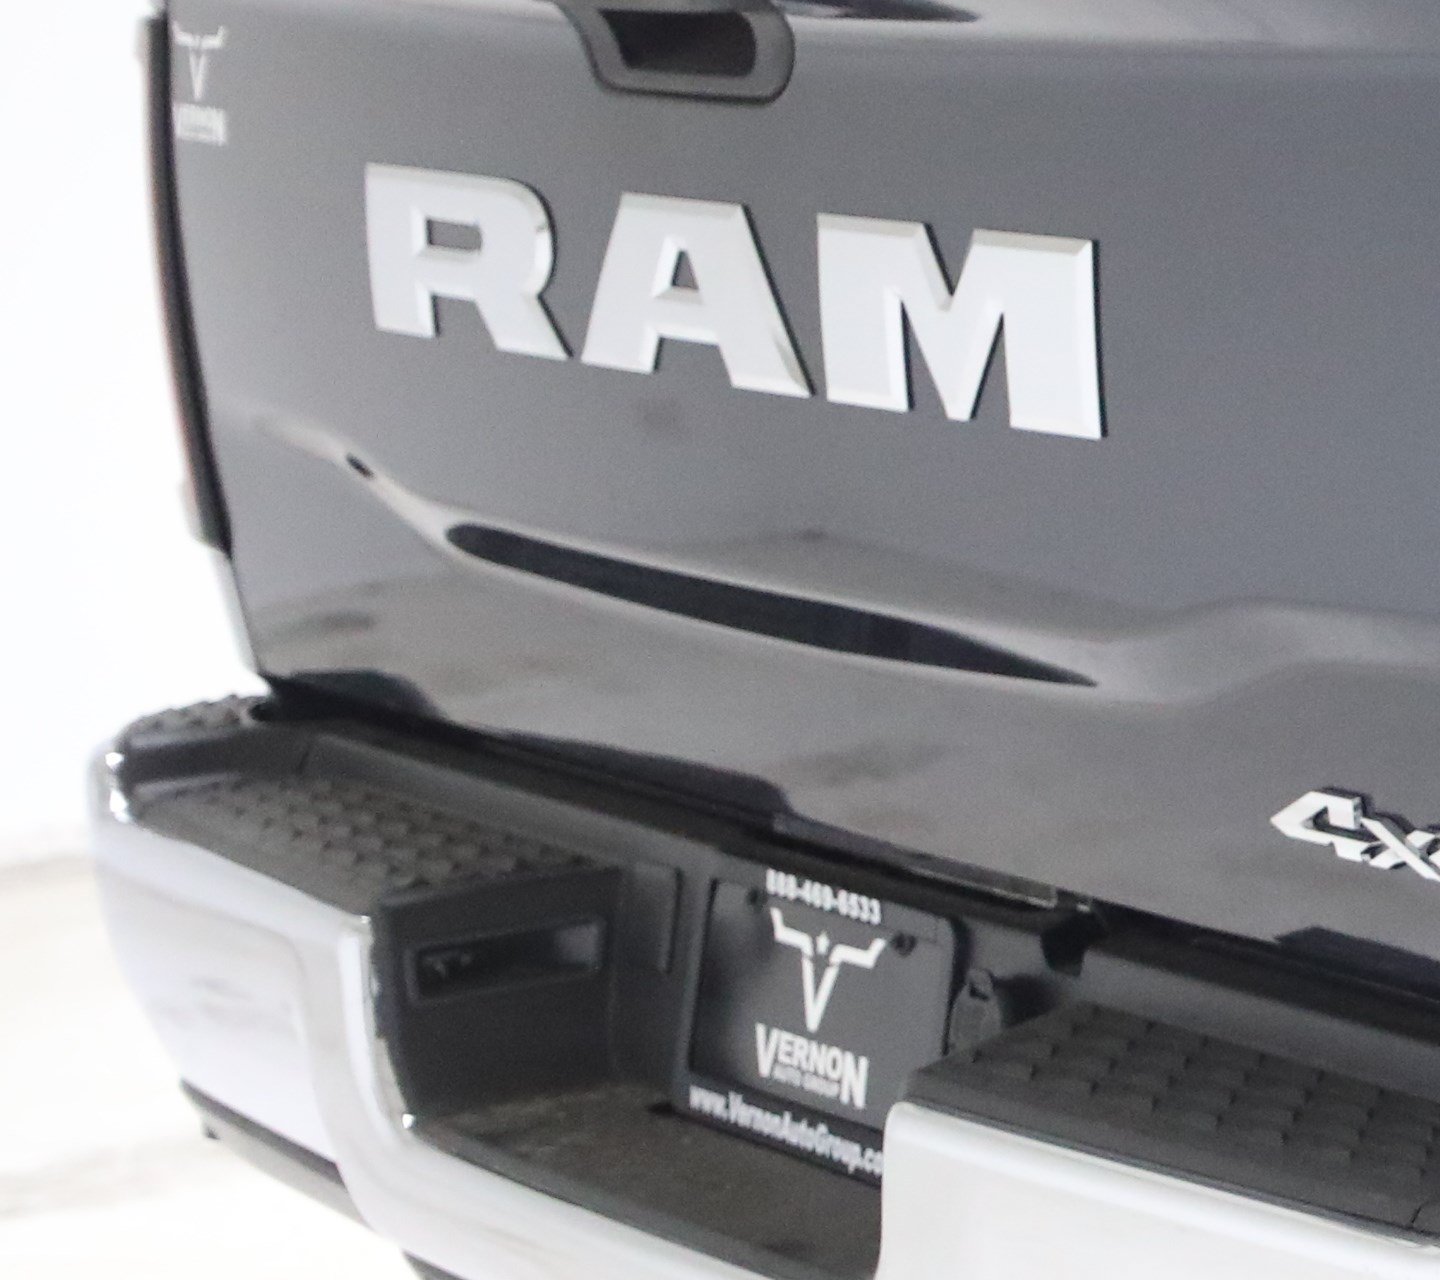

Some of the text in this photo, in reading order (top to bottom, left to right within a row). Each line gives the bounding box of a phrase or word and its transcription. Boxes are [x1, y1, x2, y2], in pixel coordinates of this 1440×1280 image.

[365, 162, 1107, 440] RAM
[754, 1022, 870, 1110] VERNON
[688, 1083, 883, 1178] www.VernonAutoGroup.co
